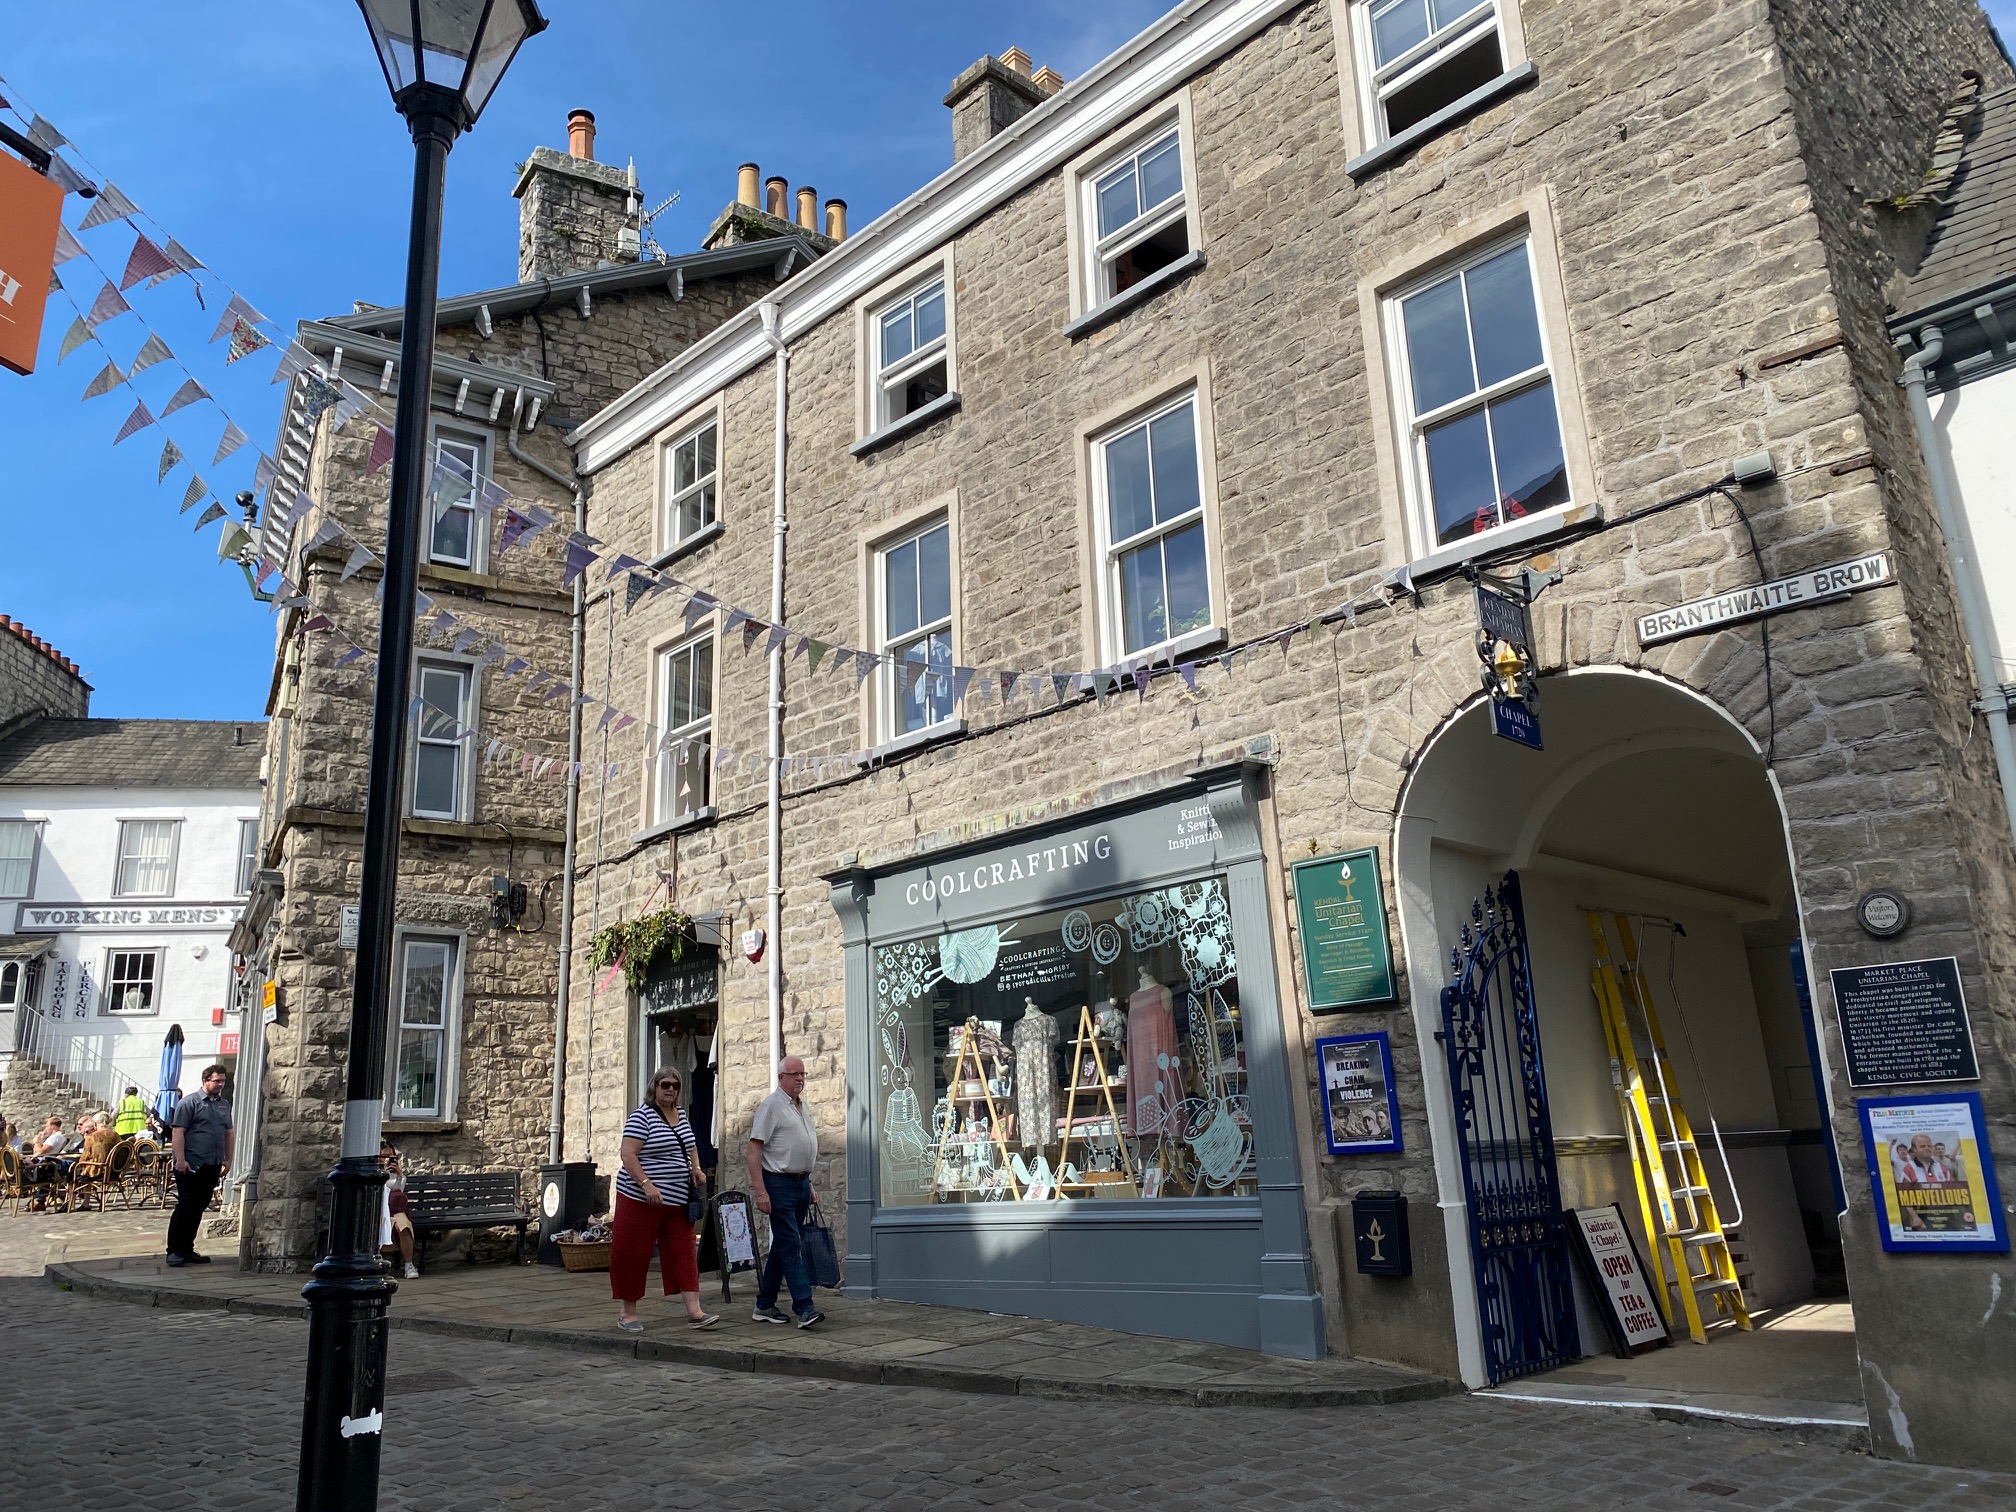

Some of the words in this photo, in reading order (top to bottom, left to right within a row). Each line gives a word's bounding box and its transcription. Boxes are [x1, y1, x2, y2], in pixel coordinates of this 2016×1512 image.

[1643, 580, 1803, 637] BRANTHWAITE
[1813, 558, 1882, 594] BROW
[1484, 597, 1517, 622] KENDAL
[1480, 609, 1525, 639] UNITARIAN
[1500, 705, 1532, 728] CHAPEL
[1177, 824, 1185, 835] &
[906, 835, 1111, 906] COOLCRAFTING
[1314, 897, 1342, 906] KENDAL
[30, 910, 141, 925] WORKING
[148, 909, 225, 924] MENS'
[1316, 904, 1363, 918] Unitarian
[1329, 913, 1364, 927] Chapel
[1004, 946, 1061, 964] COOLCRAFTING
[1000, 971, 1034, 983] BETHAN
[1858, 975, 1898, 984] UNITARIAN
[1901, 972, 1930, 980] CHAPEL
[1864, 969, 1895, 977] MARKET
[52, 961, 68, 1019] TATTOOING
[75, 961, 92, 1018] PIERCING
[1891, 991, 1932, 999] congregation
[1846, 1002, 1875, 1010] dedicated
[1900, 1004, 1932, 1012] prominent
[1336, 1060, 1370, 1072] BREAKING
[1925, 1069, 1958, 1077] SOCIETY
[1345, 1075, 1365, 1086] CHAIN
[1340, 1089, 1373, 1101] VIOLENCE
[1899, 1189, 1970, 1206] MARVELLOUS
[1585, 1220, 1619, 1234] Unitarian
[1596, 1233, 1620, 1247] Chapel
[1602, 1255, 1634, 1279] OPEN
[1621, 1278, 1631, 1290] for
[1619, 1295, 1639, 1313] TEA
[1637, 1296, 1646, 1309] &
[1625, 1312, 1658, 1334] COFFEE
